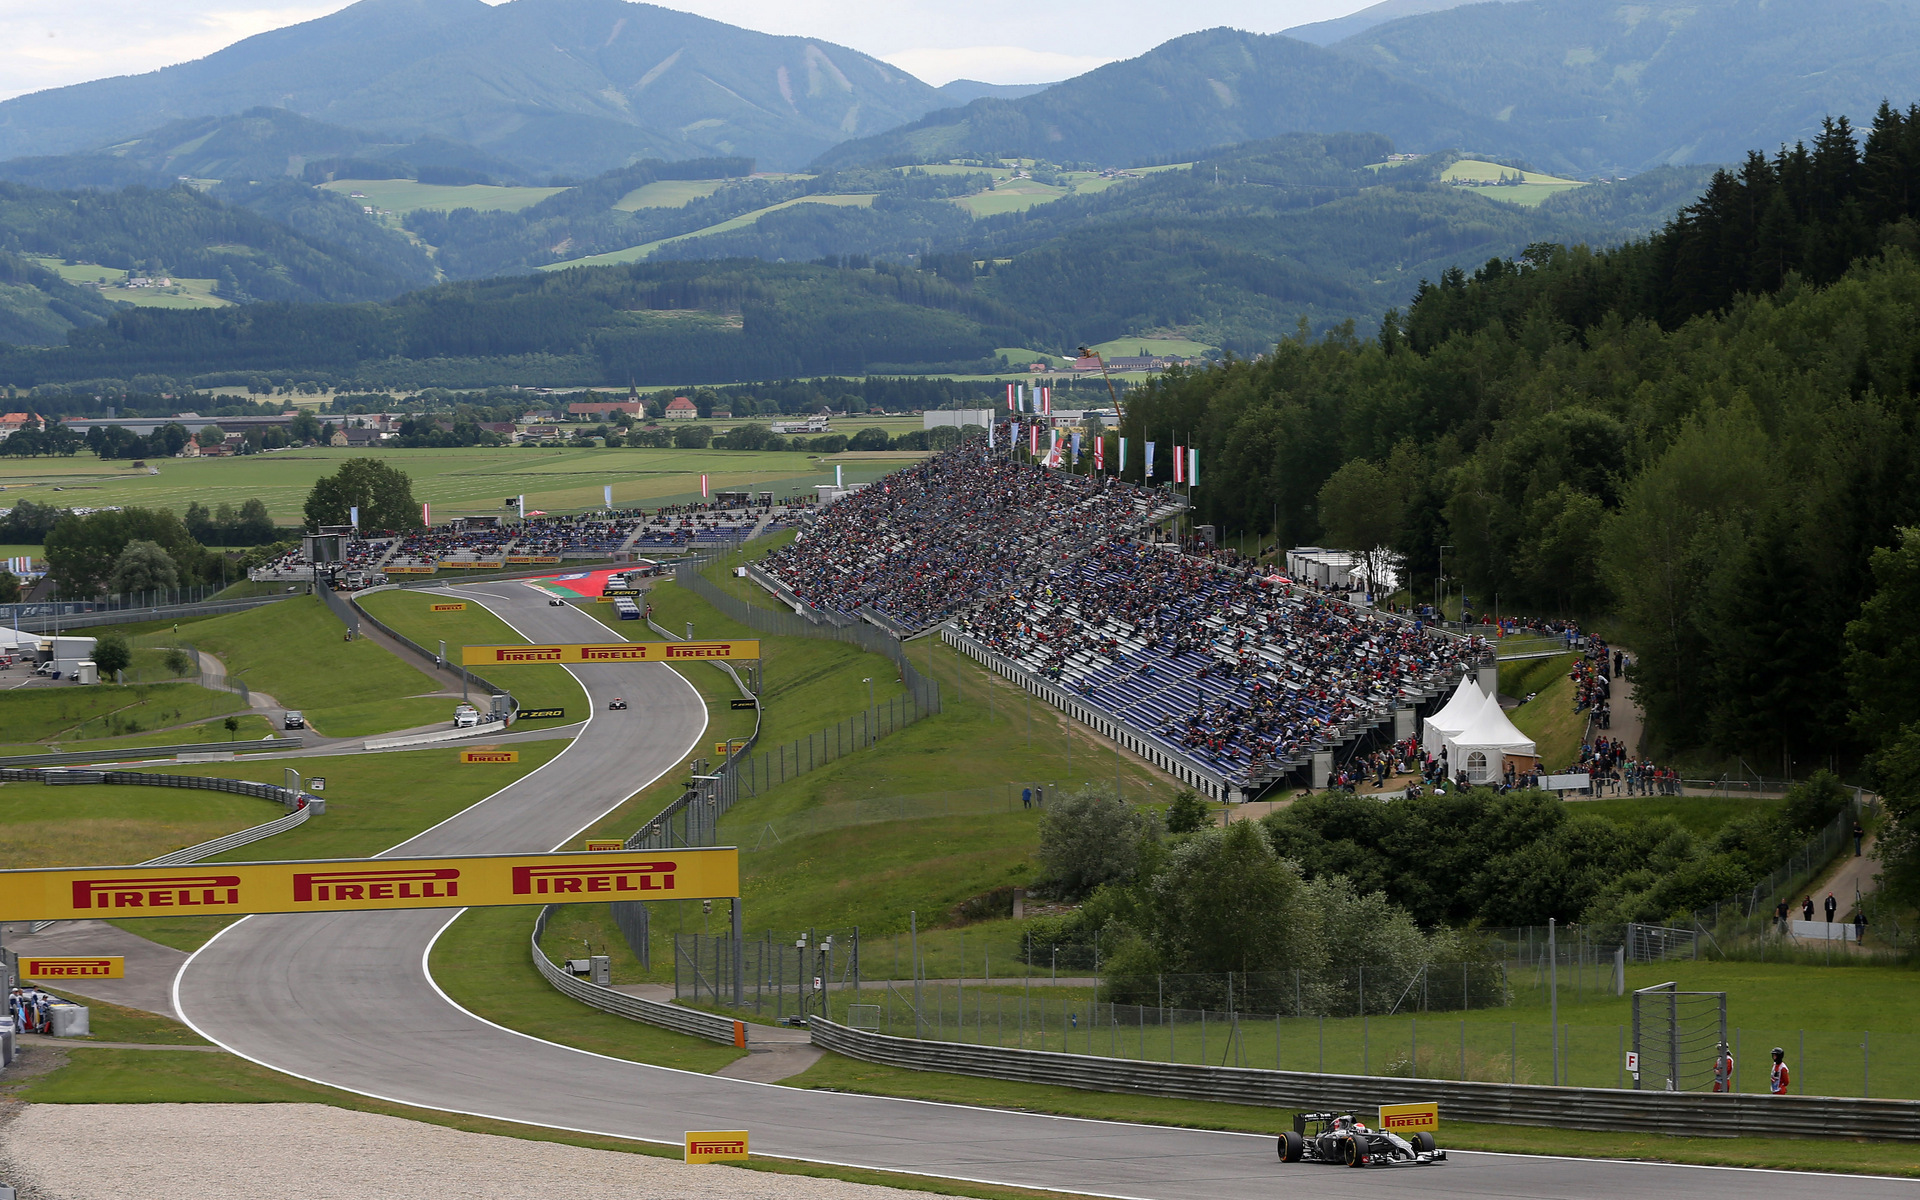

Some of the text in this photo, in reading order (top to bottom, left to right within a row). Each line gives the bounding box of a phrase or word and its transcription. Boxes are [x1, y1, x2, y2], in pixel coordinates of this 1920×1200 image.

[497, 644, 730, 661] PIRELLI PIRELLI PIRELLI
[72, 861, 677, 909] PIRELLI PIRELLI PIRELLI
[30, 961, 111, 975] PIRELLI
[1629, 1056, 1635, 1067] F
[1385, 1113, 1434, 1127] PIRELLI
[691, 1141, 744, 1154] PIRELLI
